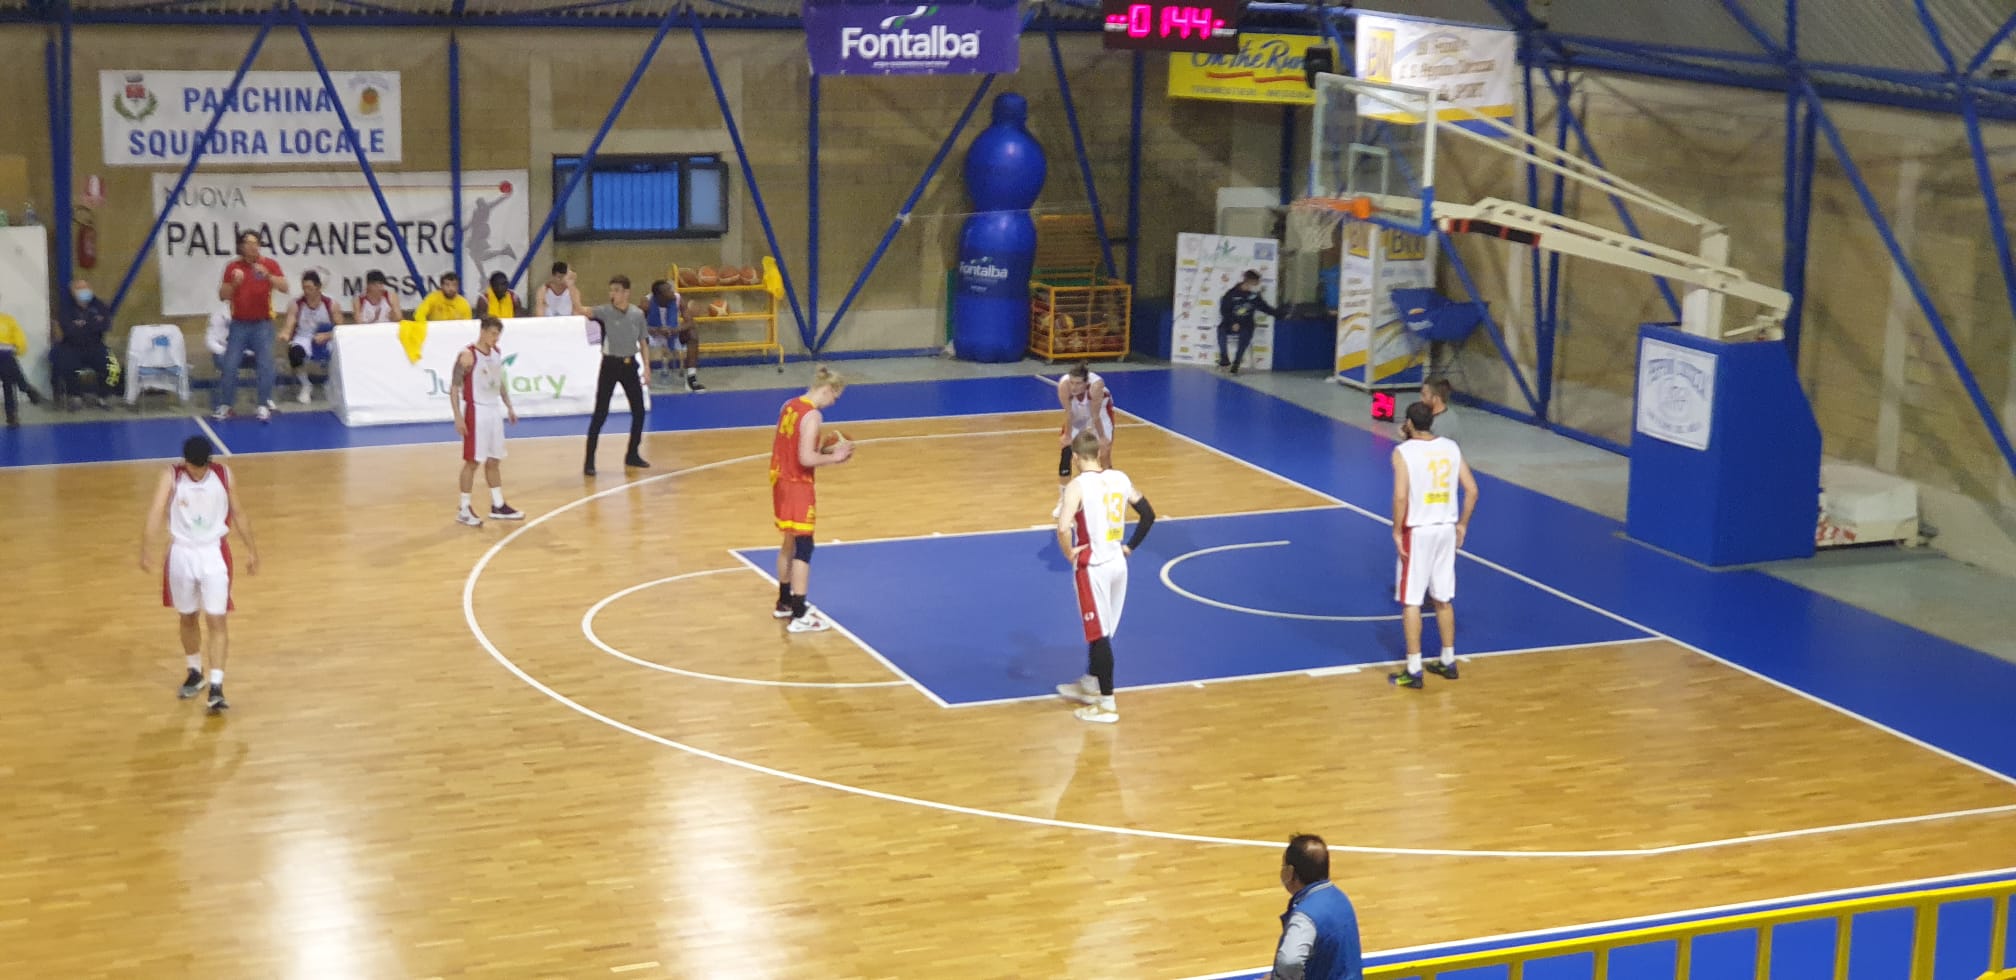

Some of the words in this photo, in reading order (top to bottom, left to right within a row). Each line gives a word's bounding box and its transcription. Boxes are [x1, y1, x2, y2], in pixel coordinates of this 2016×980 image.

[841, 25, 980, 60] Fontalba
[183, 87, 333, 113] PANCHINA
[129, 129, 268, 158] SQUADRA
[280, 128, 385, 155] LOCALE
[1428, 458, 1451, 489] 12
[1102, 492, 1124, 523] 13
